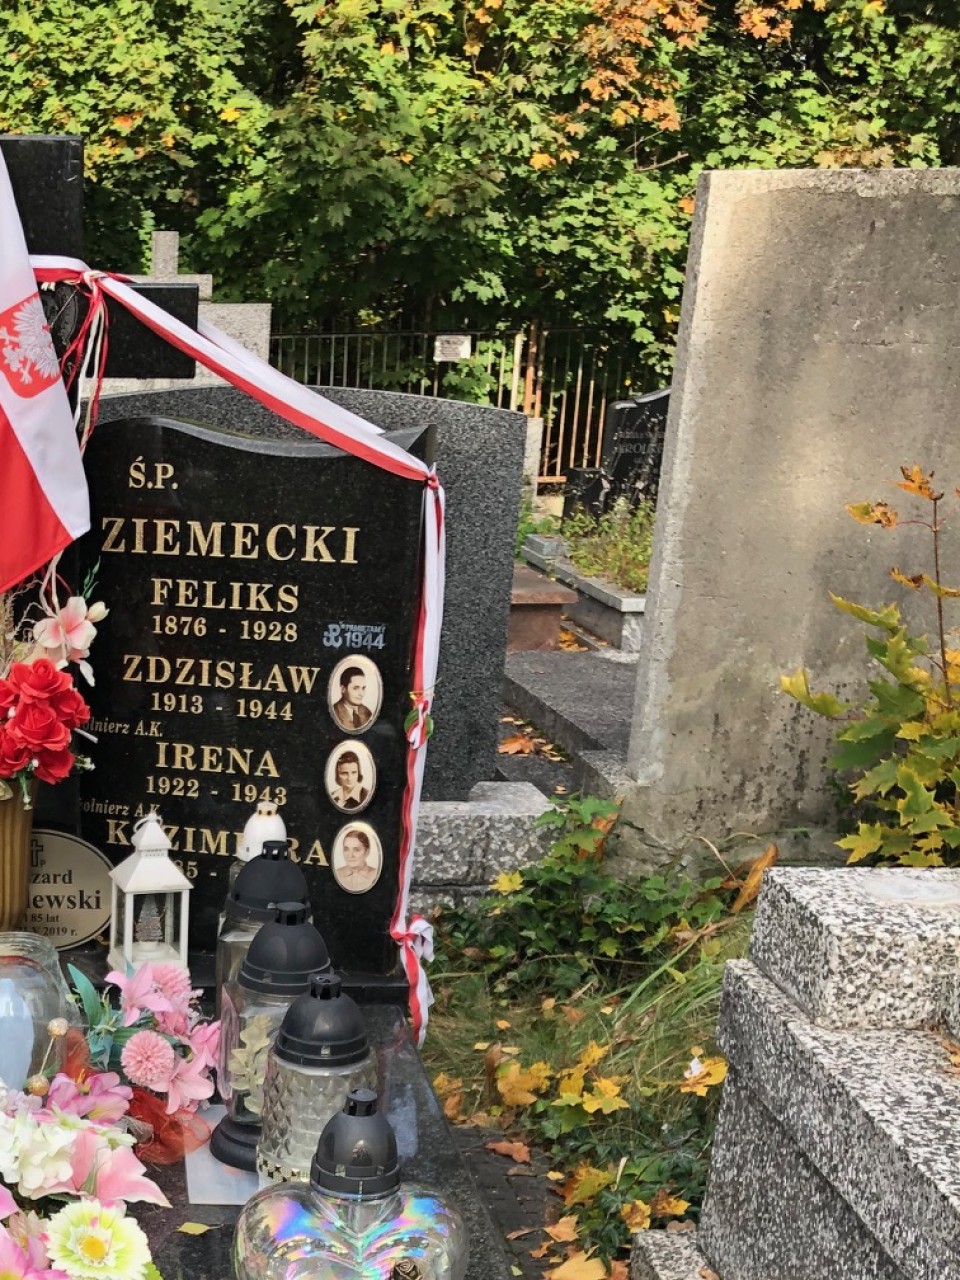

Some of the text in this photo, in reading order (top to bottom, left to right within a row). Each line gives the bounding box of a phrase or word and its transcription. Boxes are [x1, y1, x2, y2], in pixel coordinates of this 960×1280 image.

[101, 517, 361, 564] ZIEMECKI
[150, 578, 300, 613] FELIKS
[151, 615, 207, 637] 1876
[240, 619, 298, 642] 1928
[344, 631, 386, 651] 1944
[122, 655, 321, 694] ZDZISŁAW
[150, 692, 204, 715] 1913
[236, 698, 293, 721] 1944
[134, 719, 164, 738] A.K.
[155, 742, 280, 778] IRENA
[145, 775, 200, 798] 1922
[232, 783, 287, 806] 1943
[28, 869, 73, 885] zard
[43, 926, 68, 937] 2019
[46, 913, 60, 922] lat
